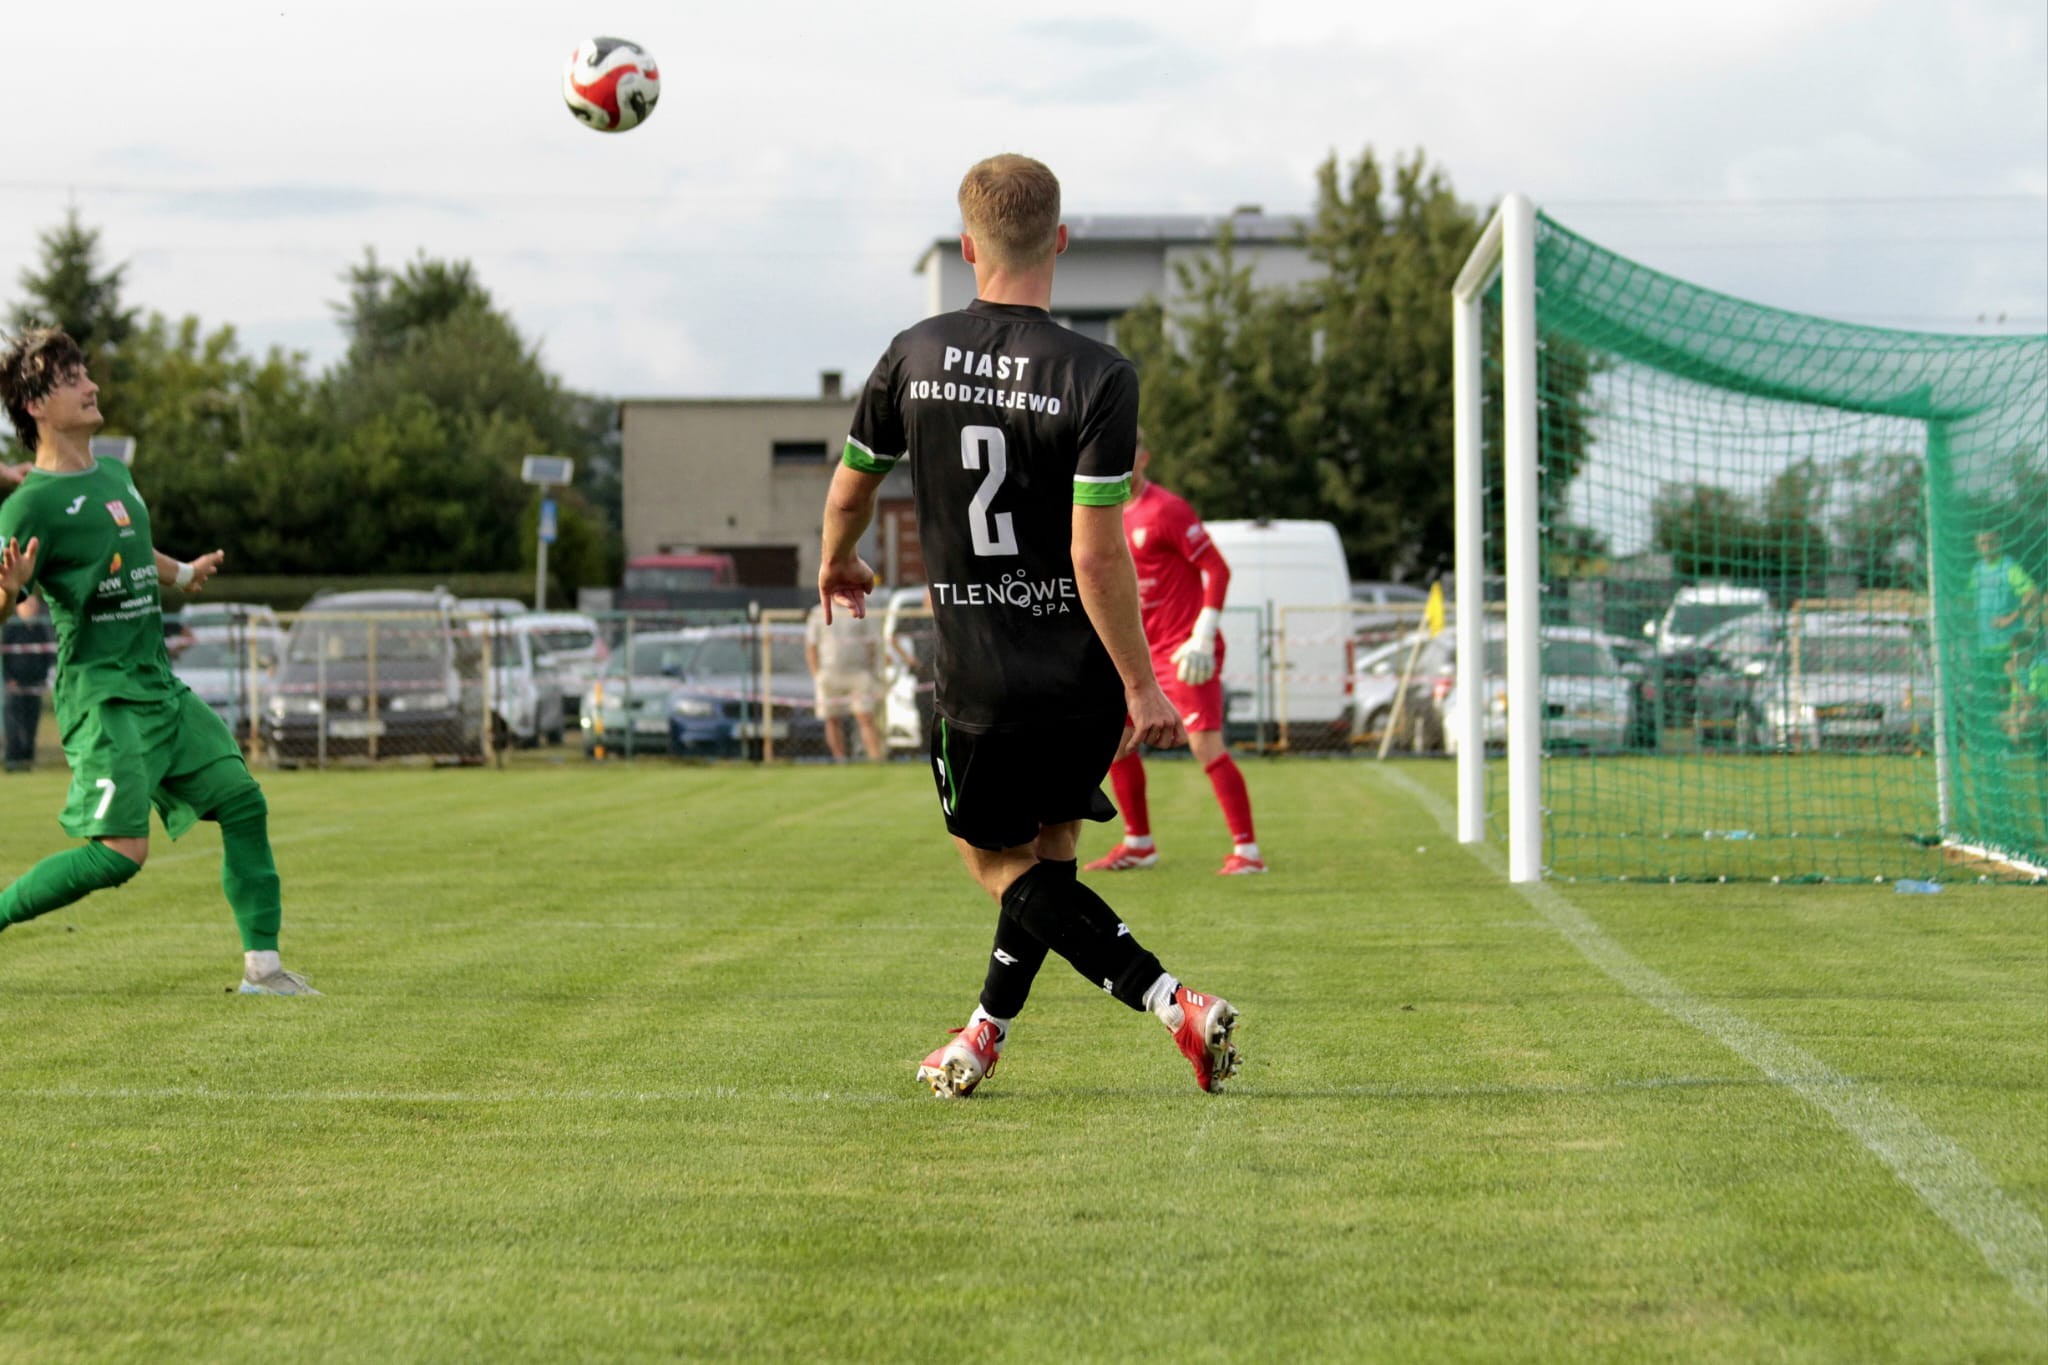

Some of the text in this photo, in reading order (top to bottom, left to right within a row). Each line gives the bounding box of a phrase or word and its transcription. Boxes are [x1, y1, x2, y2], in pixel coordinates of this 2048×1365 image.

[944, 346, 1029, 381] PIAST
[910, 380, 1060, 415] KOŁODZIEJEWO
[961, 425, 1019, 556] 2
[934, 578, 1075, 607] TLENOWE
[1032, 602, 1070, 616] SPA
[95, 778, 116, 819] 7
